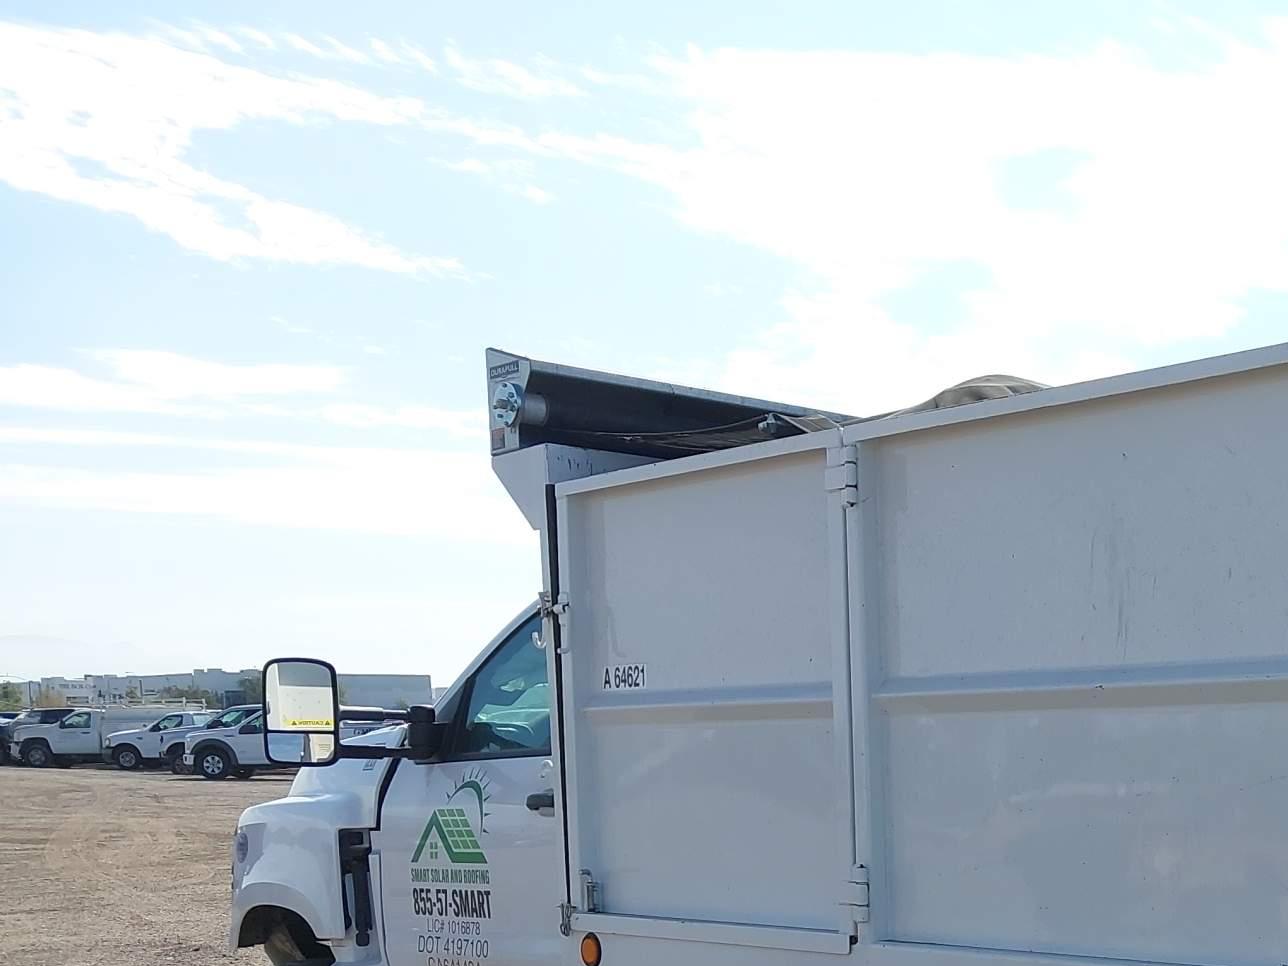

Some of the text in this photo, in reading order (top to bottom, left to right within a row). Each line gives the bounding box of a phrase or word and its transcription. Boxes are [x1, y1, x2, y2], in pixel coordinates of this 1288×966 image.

[603, 665, 645, 689] A 64621
[411, 868, 490, 885] SMART SOLAR AND ROOFING
[412, 887, 491, 919] 855-57-SMART
[426, 919, 480, 936] LIC# 1016878
[418, 935, 489, 958] DOT 4197100
